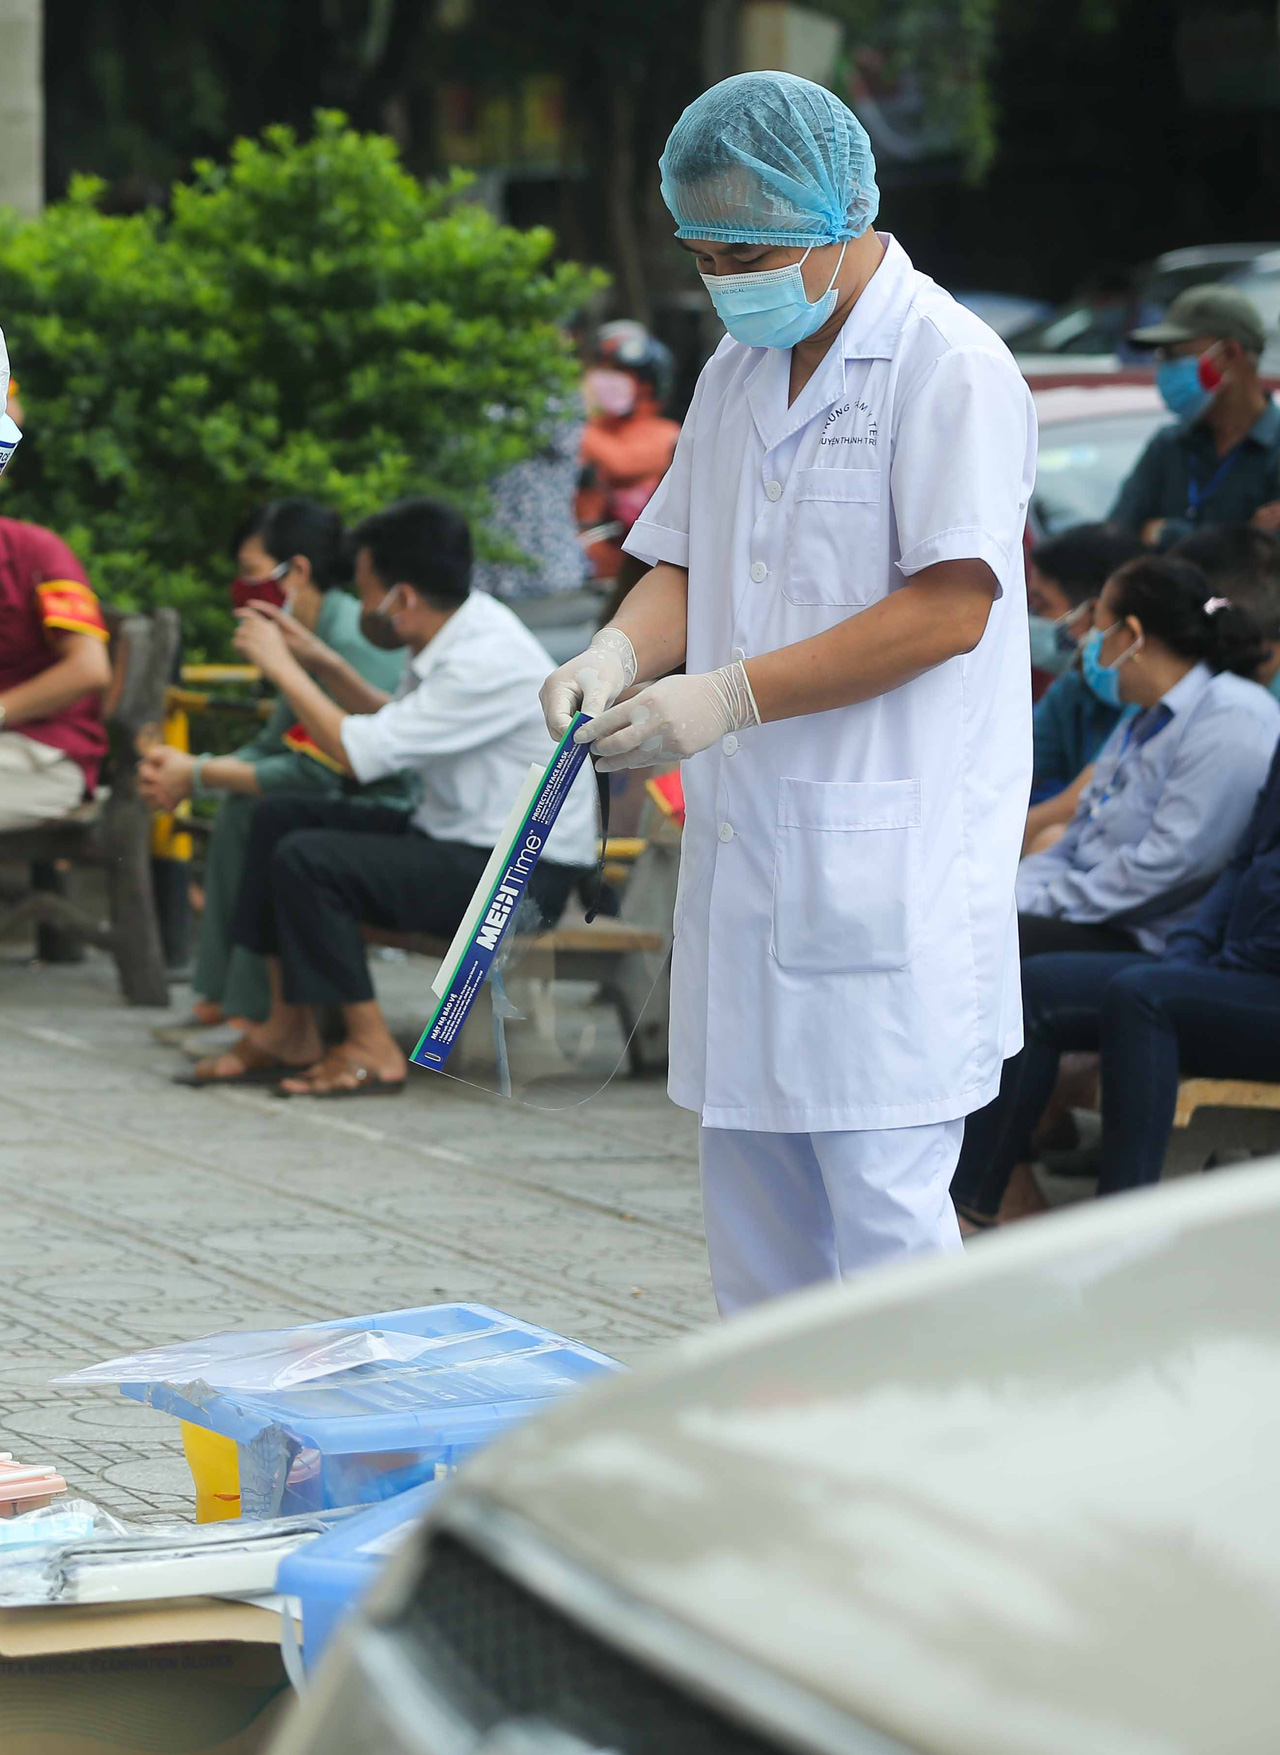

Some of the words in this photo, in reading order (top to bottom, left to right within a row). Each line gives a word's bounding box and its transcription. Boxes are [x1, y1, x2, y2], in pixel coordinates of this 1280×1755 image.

[822, 403, 850, 435] RUNG
[531, 783, 553, 821] PROTECTIVE
[548, 768, 560, 784] FACE
[556, 749, 569, 769] MASK
